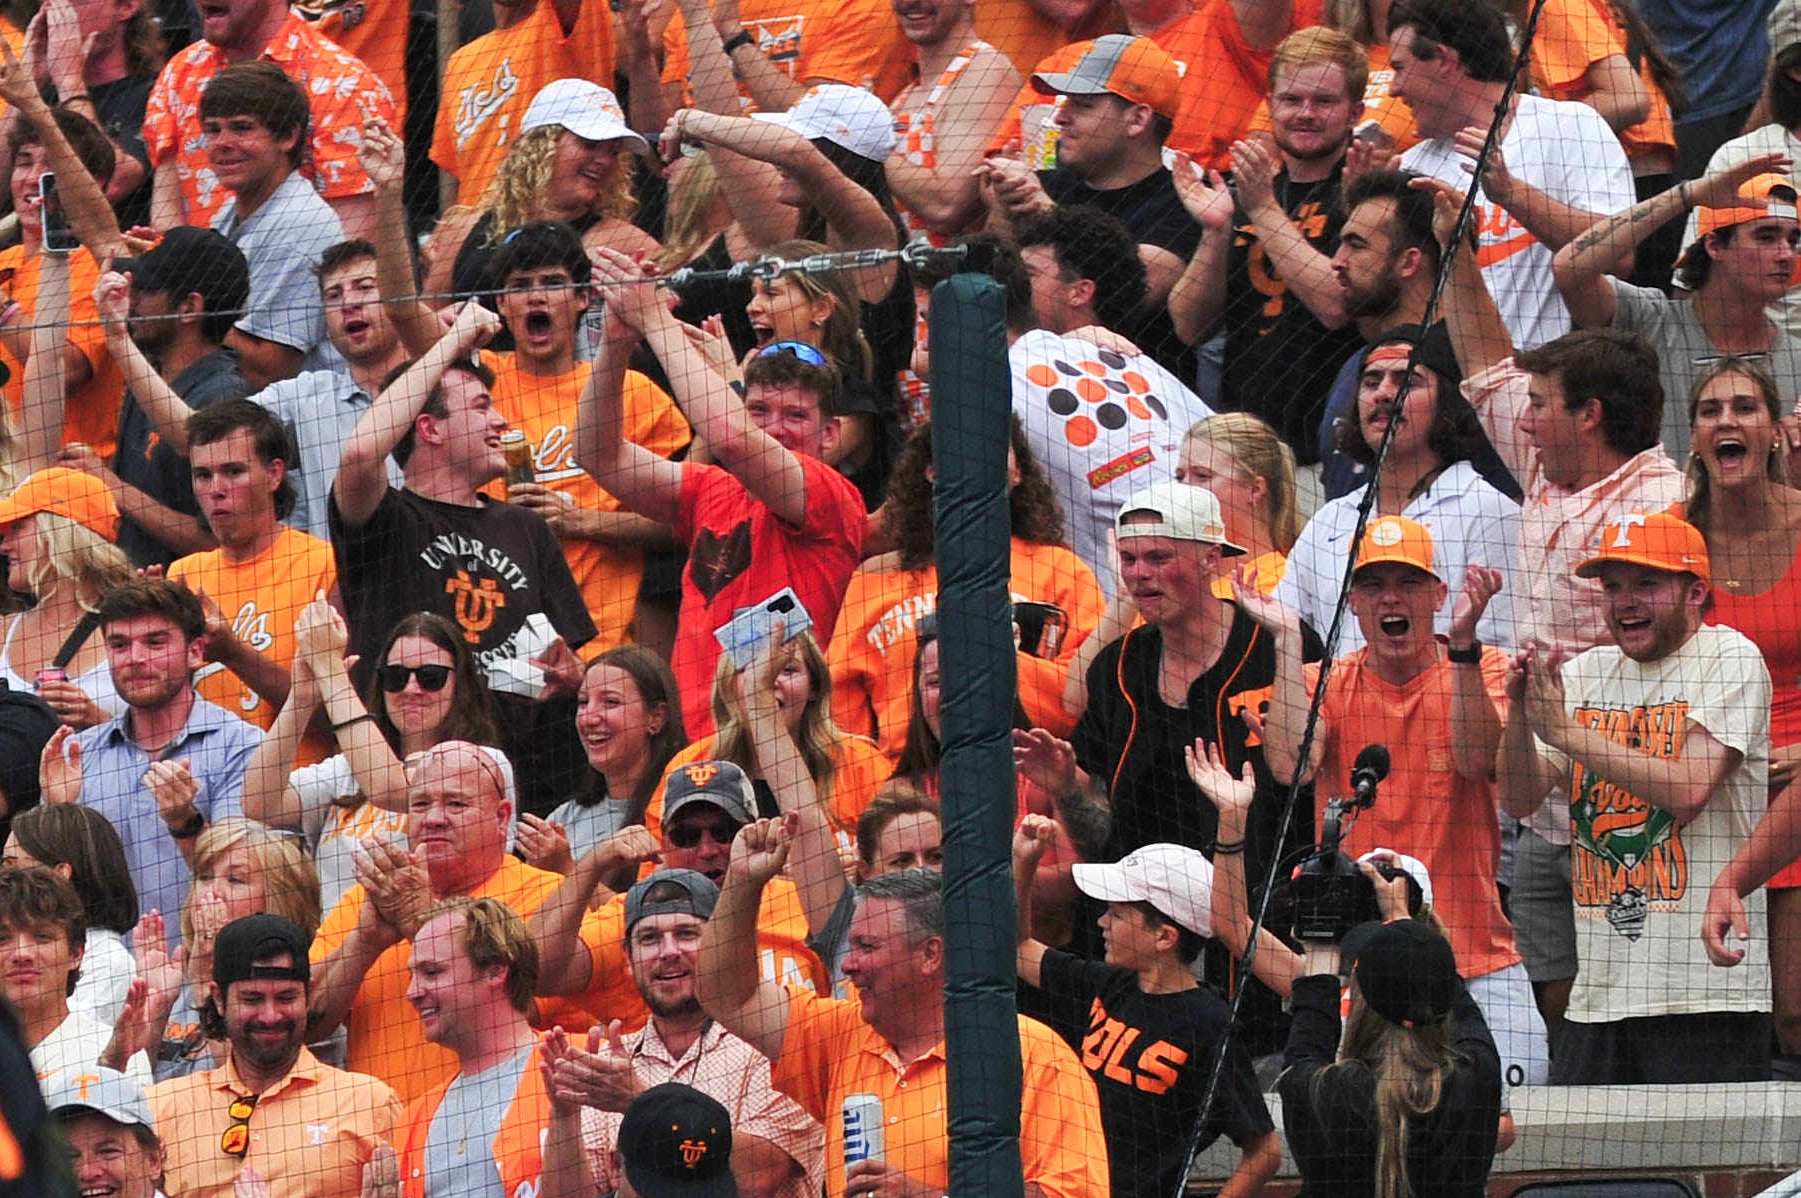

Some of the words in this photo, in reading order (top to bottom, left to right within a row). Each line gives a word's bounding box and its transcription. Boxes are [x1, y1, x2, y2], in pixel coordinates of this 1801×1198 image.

[1611, 515, 1646, 547] T
[72, 1074, 99, 1100] T
[306, 1125, 329, 1145] T
